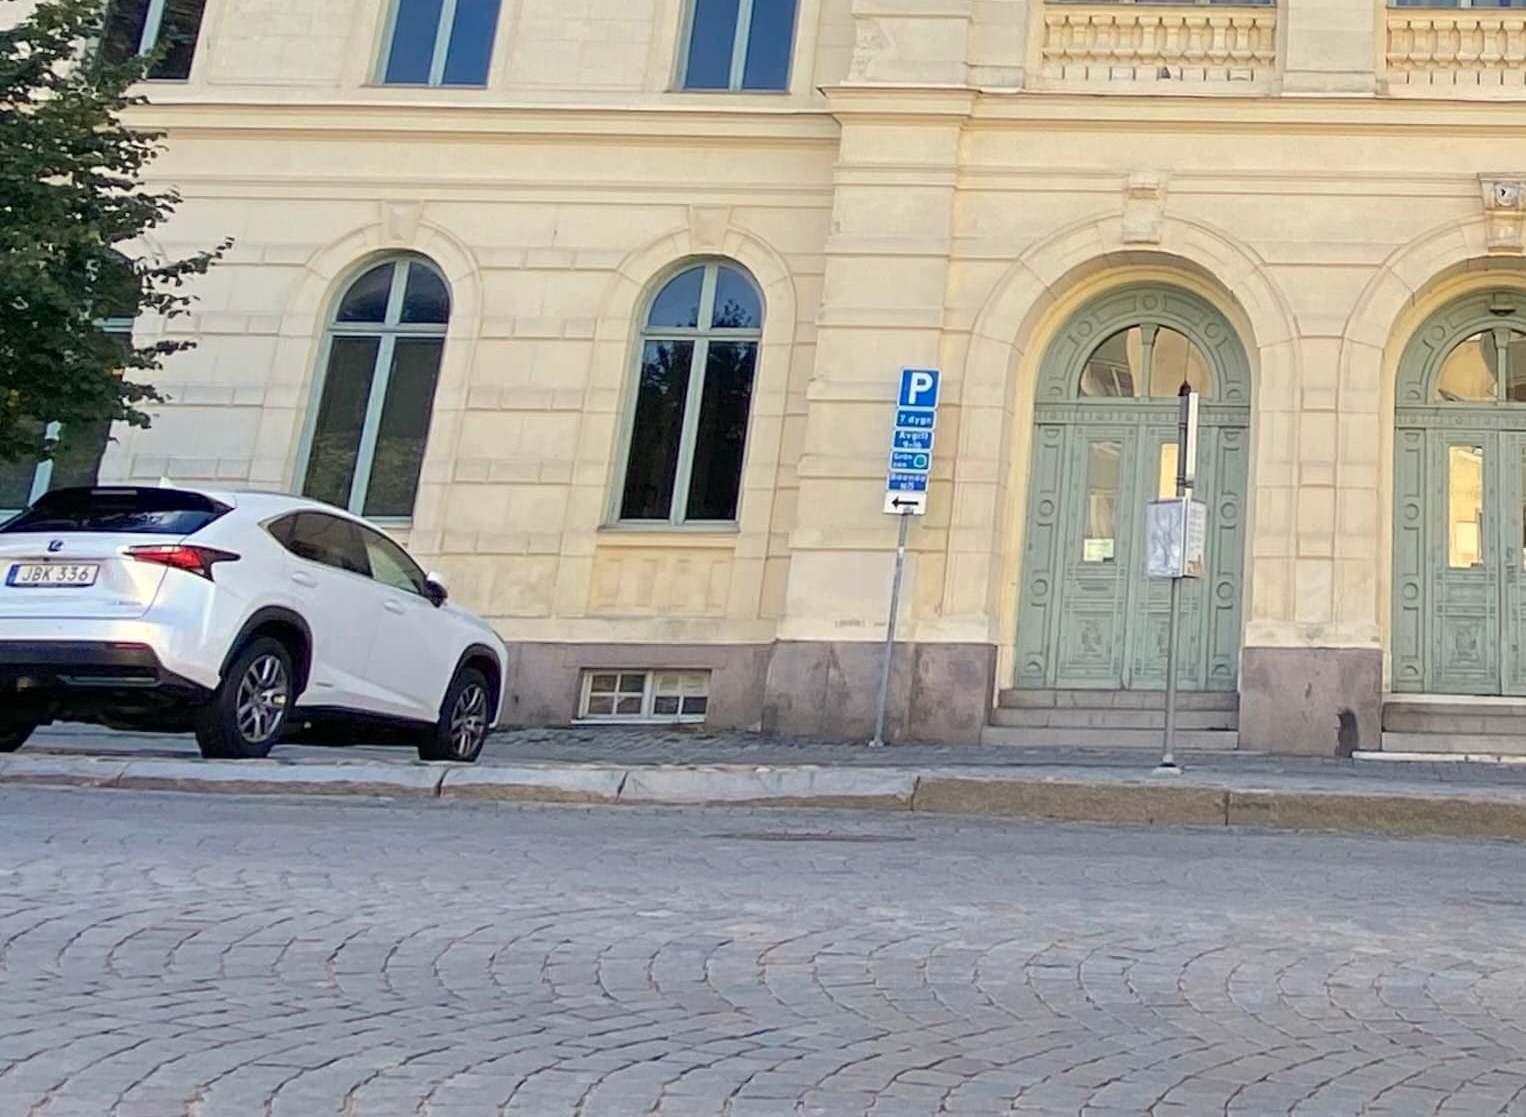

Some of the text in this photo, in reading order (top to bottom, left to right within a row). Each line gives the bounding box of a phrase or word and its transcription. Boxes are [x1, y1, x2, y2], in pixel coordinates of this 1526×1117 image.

[908, 372, 933, 404] P
[899, 431, 928, 440] Avgift
[22, 565, 89, 582] JBK 336
